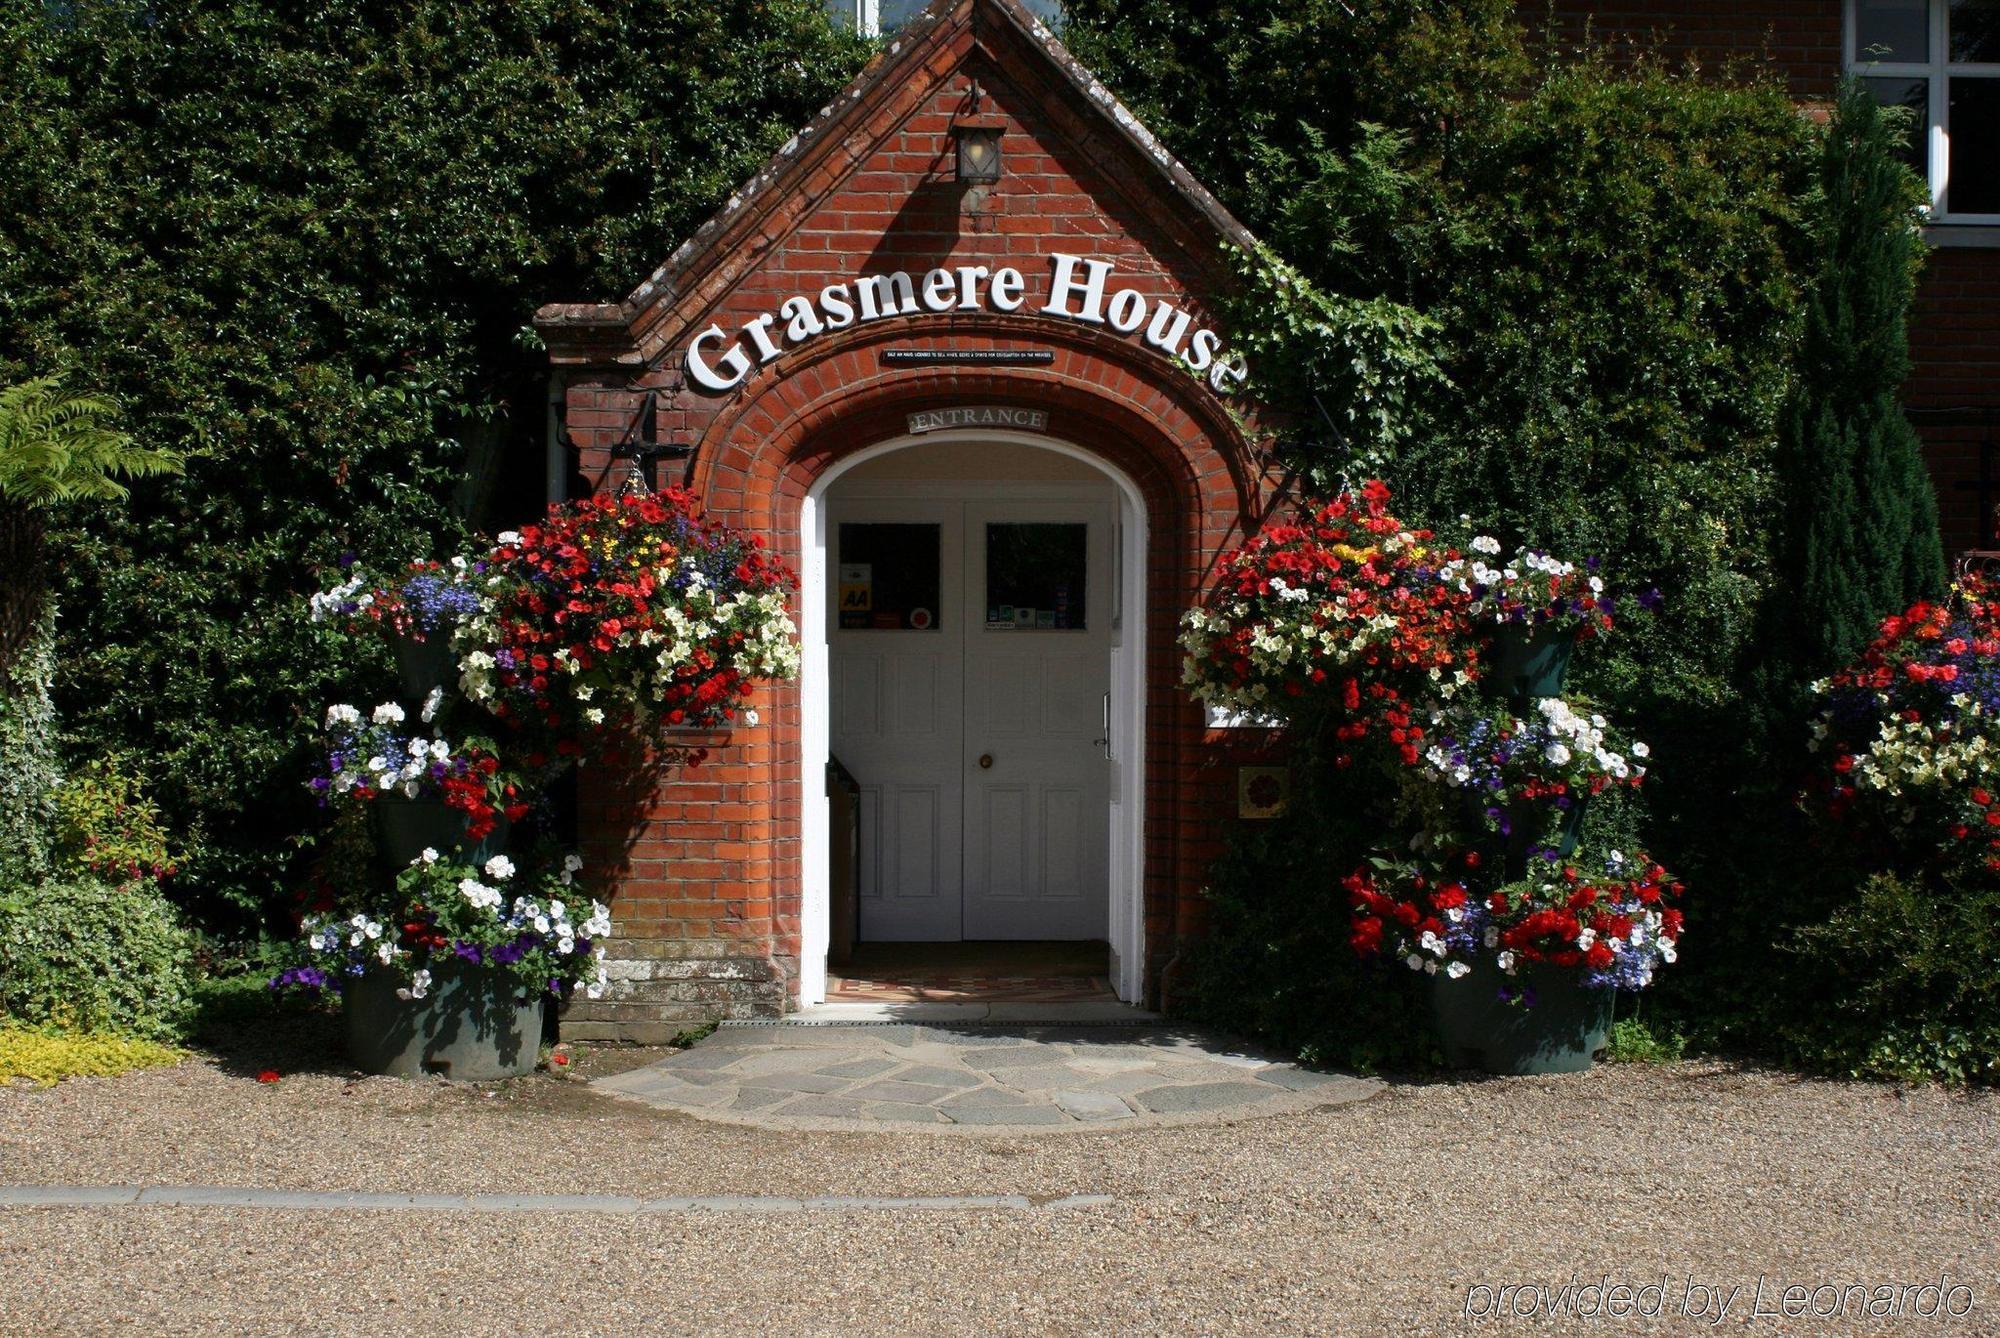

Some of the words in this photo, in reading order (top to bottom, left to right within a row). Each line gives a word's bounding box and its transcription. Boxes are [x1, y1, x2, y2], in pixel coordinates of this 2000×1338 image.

[687, 265, 1025, 390] Grasmere
[1040, 252, 1249, 394] House
[914, 408, 1042, 429] ENTRANCE
[843, 590, 868, 607] AA
